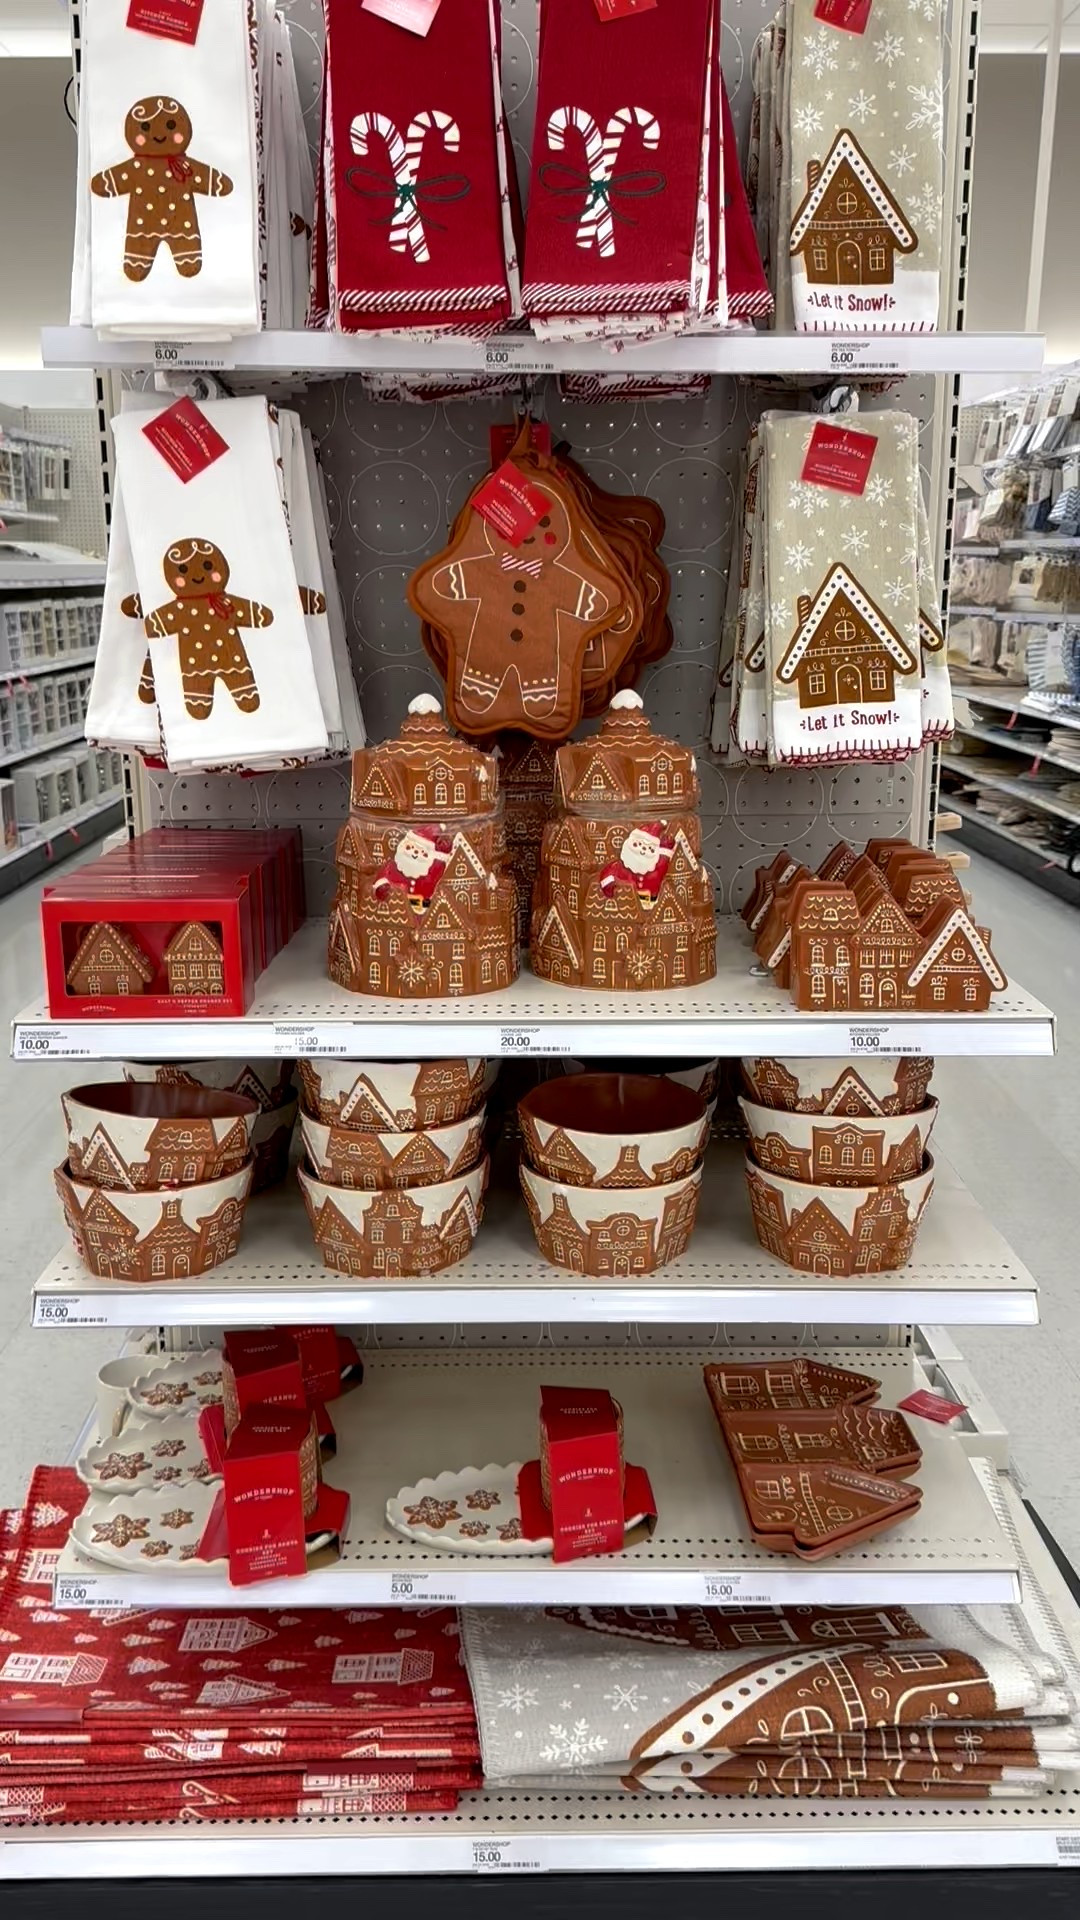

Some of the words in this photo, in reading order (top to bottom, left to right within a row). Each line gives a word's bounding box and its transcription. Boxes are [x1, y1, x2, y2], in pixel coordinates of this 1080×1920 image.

[813, 291, 833, 309] Let
[847, 293, 889, 312] Snow!
[155, 349, 178, 360] 6.00
[486, 352, 509, 363] 6.00
[831, 352, 854, 363] 6.00
[817, 442, 867, 460] WONDERSHOP
[807, 715, 829, 732] Let
[850, 709, 893, 726] Snow!
[20, 1039, 50, 1050] 10.00
[294, 1036, 318, 1046] 15.00
[500, 1036, 531, 1047] 20.00
[850, 1036, 880, 1047] 10.00
[40, 1307, 69, 1318] 15.00
[559, 1467, 615, 1483] WONDERSHOP
[233, 1487, 295, 1503] WONDERSHOP
[59, 1588, 87, 1600] 15.00
[391, 1582, 414, 1594] 5.00
[705, 1584, 733, 1596] 15.00
[473, 1851, 502, 1863] 15.00
